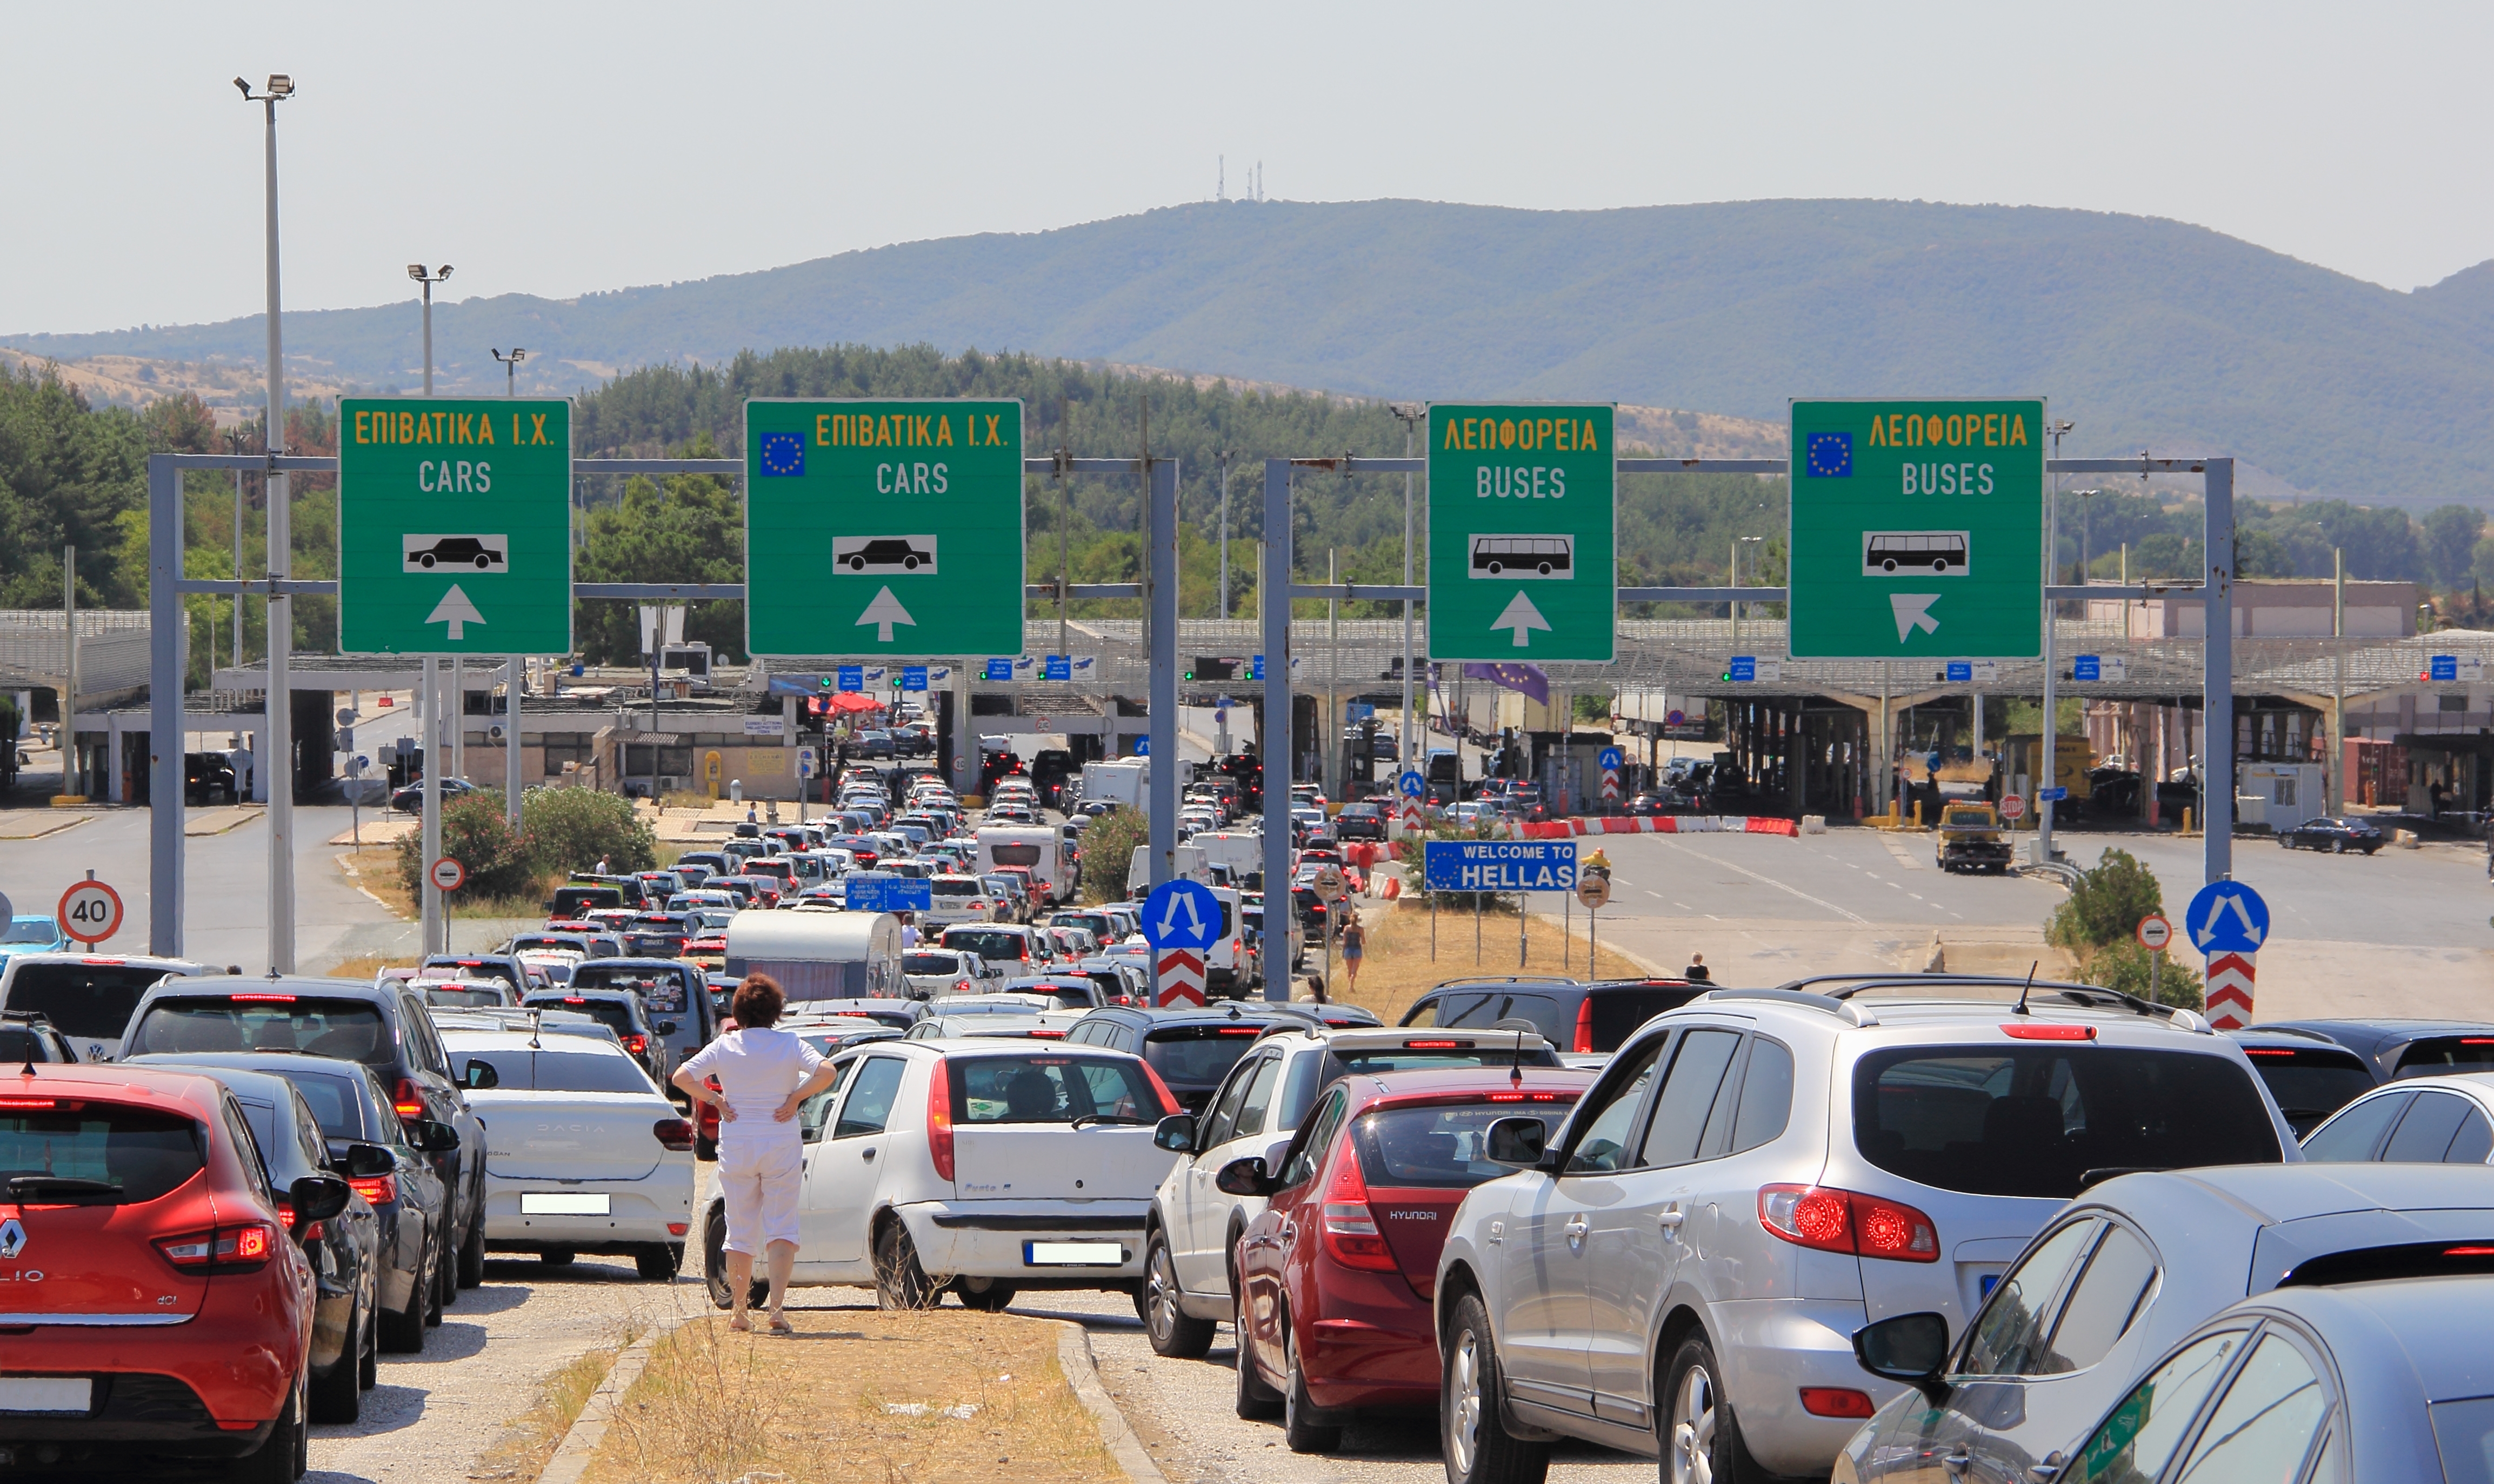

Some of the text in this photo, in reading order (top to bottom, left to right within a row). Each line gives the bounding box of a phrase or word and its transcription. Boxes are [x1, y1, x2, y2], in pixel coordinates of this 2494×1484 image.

[355, 411, 495, 445] ΕΠΙΒΑΤΙΚΑ
[816, 415, 953, 446] ΕΠΙΒΑΤΙΚΑ
[1444, 418, 1597, 451] ΛΕΩΦΟΡΕΙΑ
[1869, 414, 2028, 446] ΛΕΩΦΟΡΕΙΑ
[419, 460, 491, 493] CARS
[877, 463, 948, 494] CARS
[1477, 466, 1565, 498] BUSES
[1902, 463, 1994, 495] BUSES
[2002, 800, 2023, 813] STOP
[1463, 845, 1573, 859] WELCOME TO
[1462, 865, 1573, 887] HELLAS
[72, 900, 106, 923] 40
[537, 1124, 605, 1133] DACIA
[1390, 1211, 1437, 1220] HYUNDAI
